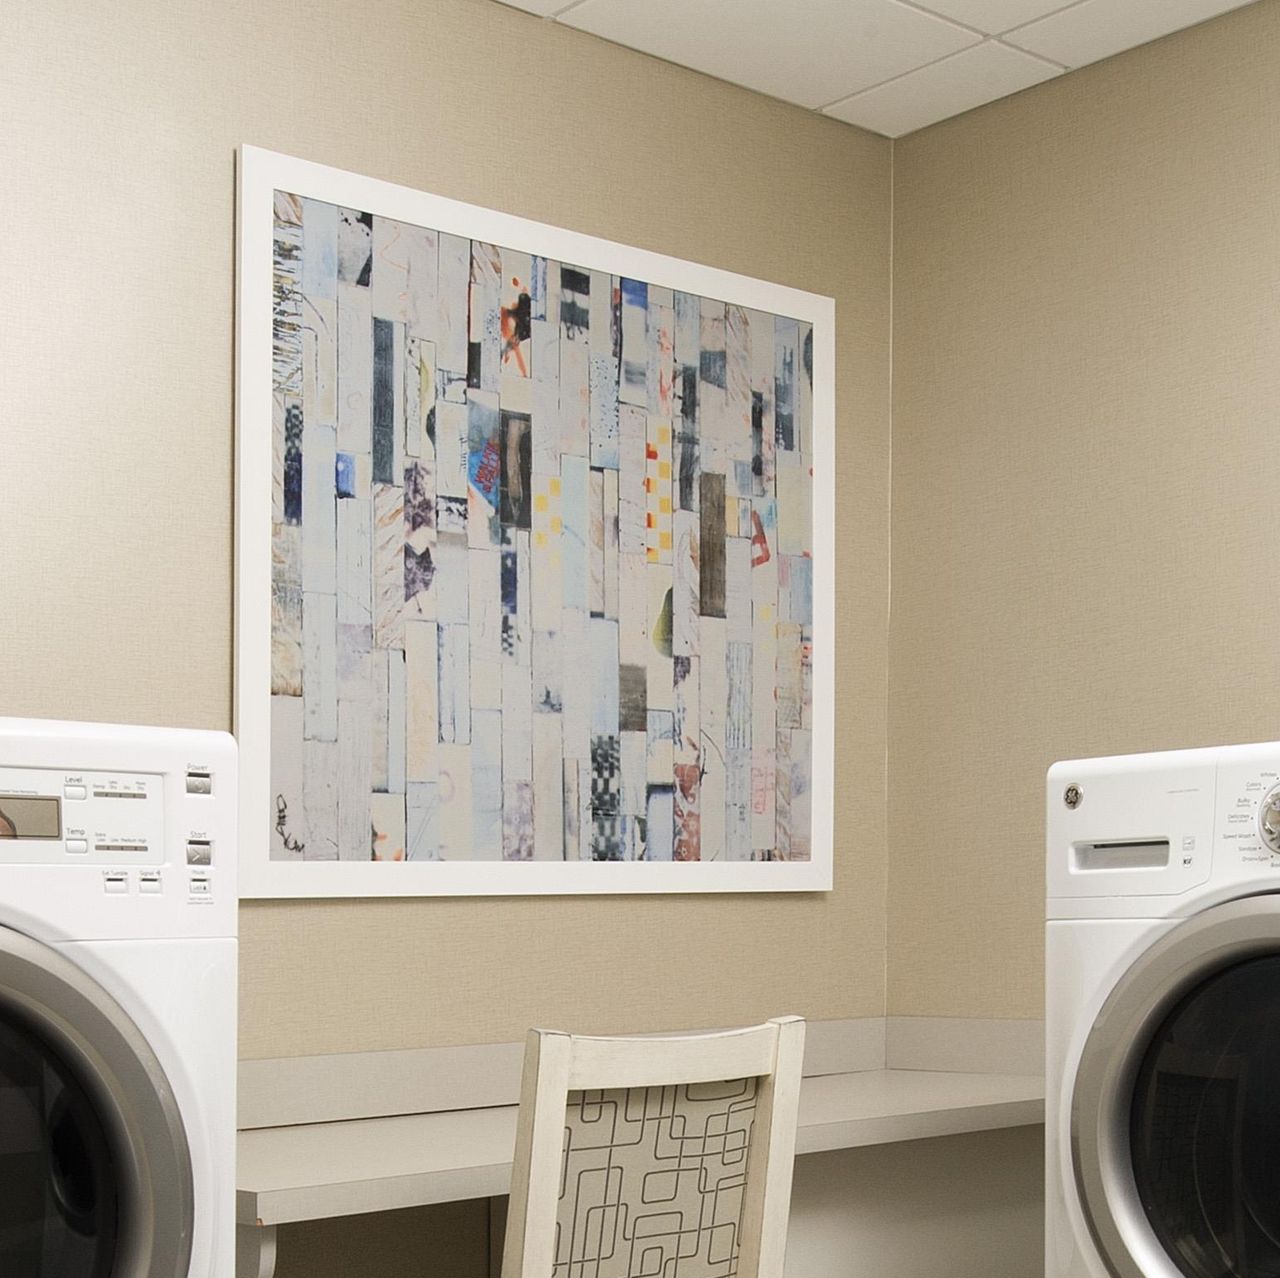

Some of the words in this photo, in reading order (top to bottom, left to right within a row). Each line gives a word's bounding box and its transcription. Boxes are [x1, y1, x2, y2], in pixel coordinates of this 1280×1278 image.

[187, 763, 207, 771] Power
[66, 828, 85, 836] Temp
[190, 830, 207, 838] Start
